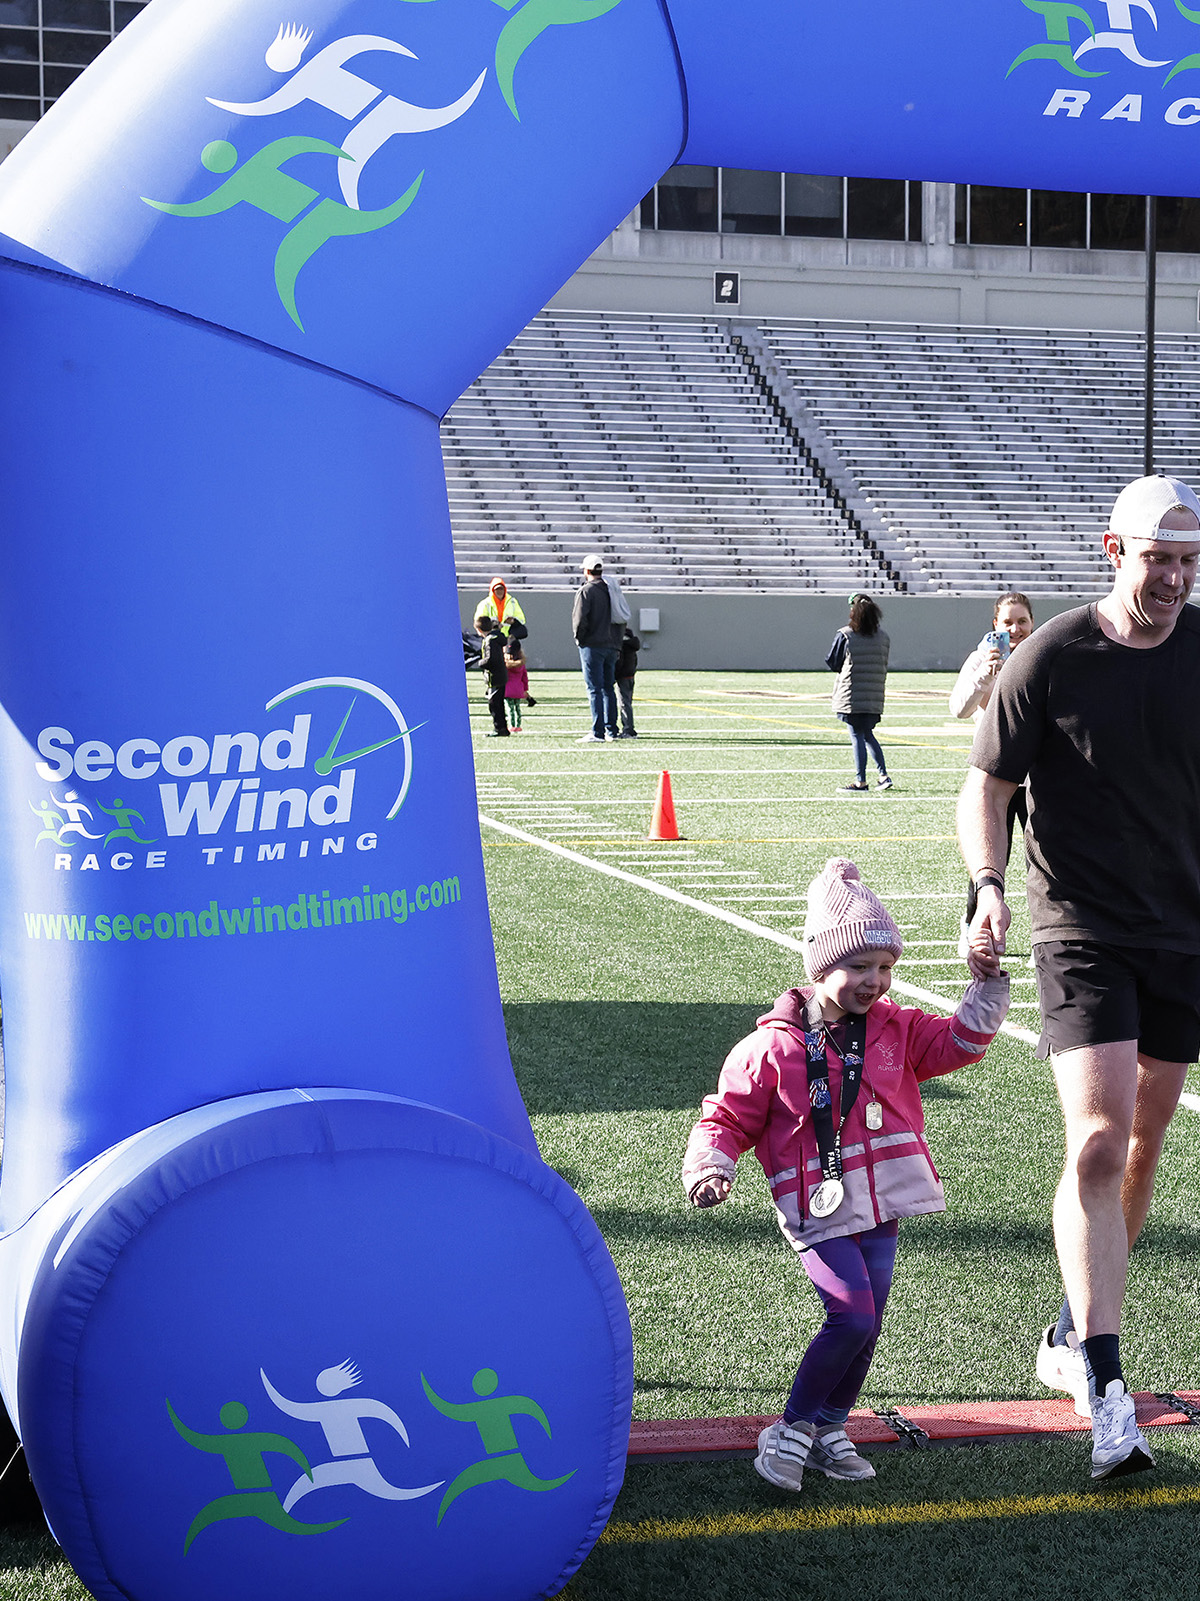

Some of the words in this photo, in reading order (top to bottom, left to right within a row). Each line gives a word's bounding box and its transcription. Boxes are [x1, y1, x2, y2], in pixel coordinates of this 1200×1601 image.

[721, 280, 733, 296] 2
[36, 713, 312, 782] Second
[159, 769, 356, 837] Wind
[54, 850, 168, 871] RACE
[202, 832, 379, 865] TIMING
[24, 875, 462, 942] www.secondwindtiming.com
[864, 930, 892, 944] WEST
